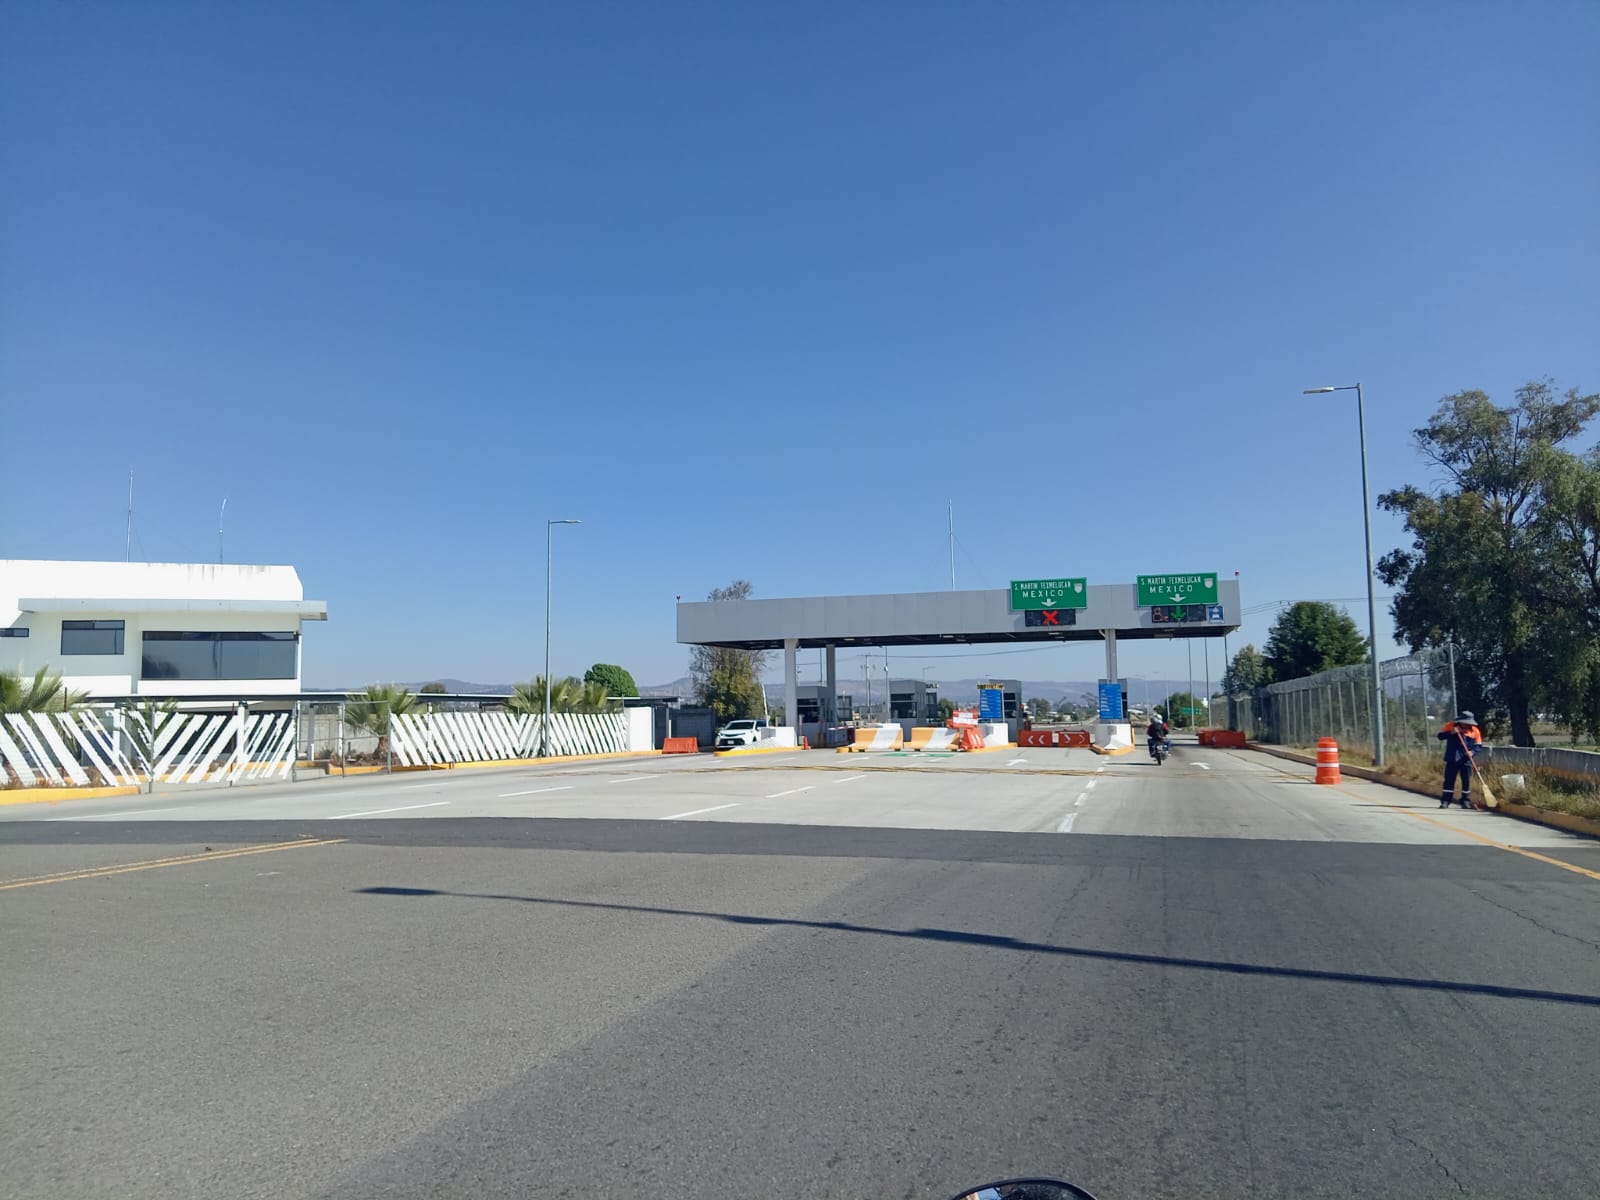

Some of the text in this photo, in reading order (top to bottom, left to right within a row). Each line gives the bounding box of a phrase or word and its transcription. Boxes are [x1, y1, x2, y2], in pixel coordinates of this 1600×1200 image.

[1147, 577, 1166, 585] MARTIN
[1168, 576, 1201, 584] TEXMELUCAN
[1020, 582, 1038, 590] MARTIN
[1040, 581, 1071, 589] TEXMELUCAN
[1149, 585, 1193, 593] MEXICO
[1022, 589, 1064, 598] MEXICO
